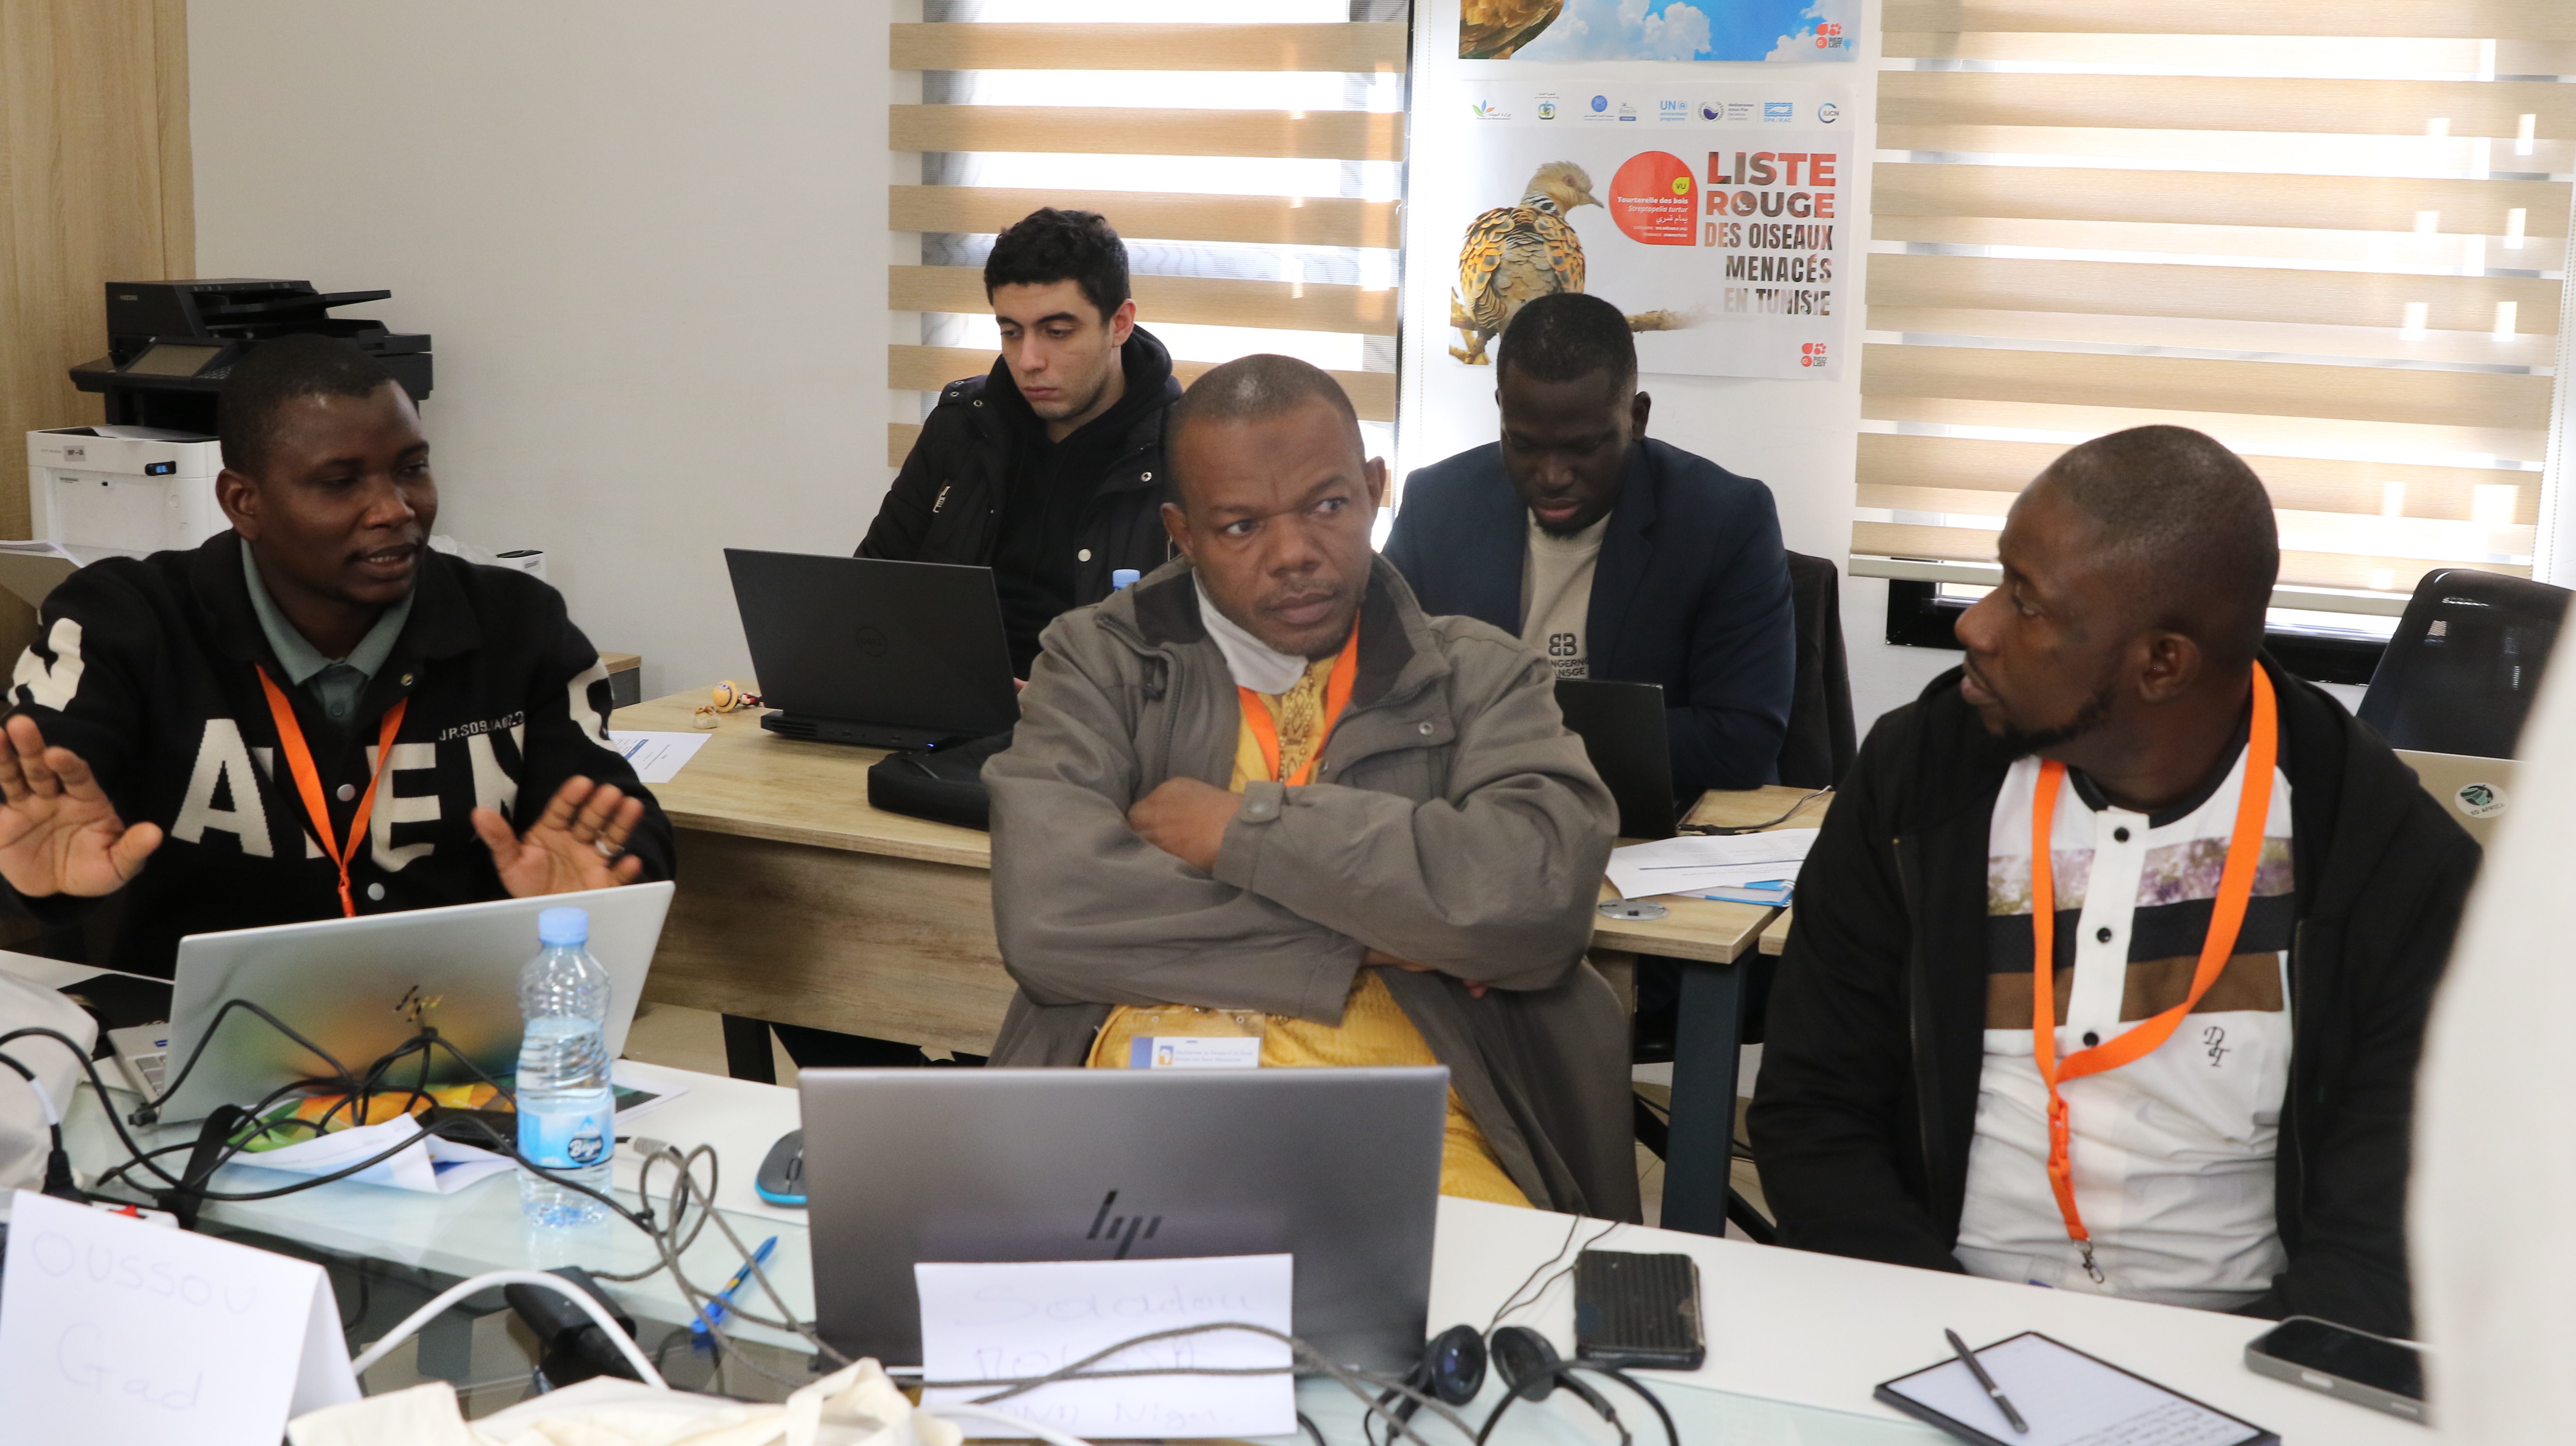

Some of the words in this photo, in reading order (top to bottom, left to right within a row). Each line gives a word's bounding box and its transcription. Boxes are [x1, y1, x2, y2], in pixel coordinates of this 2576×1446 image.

[1660, 100, 1676, 110] UN
[1707, 152, 1837, 186] LISTE
[1617, 196, 1658, 204] Tourterelle
[1628, 205, 1668, 214] Streptopelia
[1706, 191, 1835, 218] ROUGE
[1704, 222, 1741, 248] DES
[1749, 223, 1834, 250] OISEAUX
[1726, 253, 1832, 283] MENACÉS
[1723, 287, 1748, 313] EN
[1755, 289, 1831, 316] TUNISIE
[31, 1229, 258, 1315] OUSSOU
[56, 1321, 204, 1412] Gad
